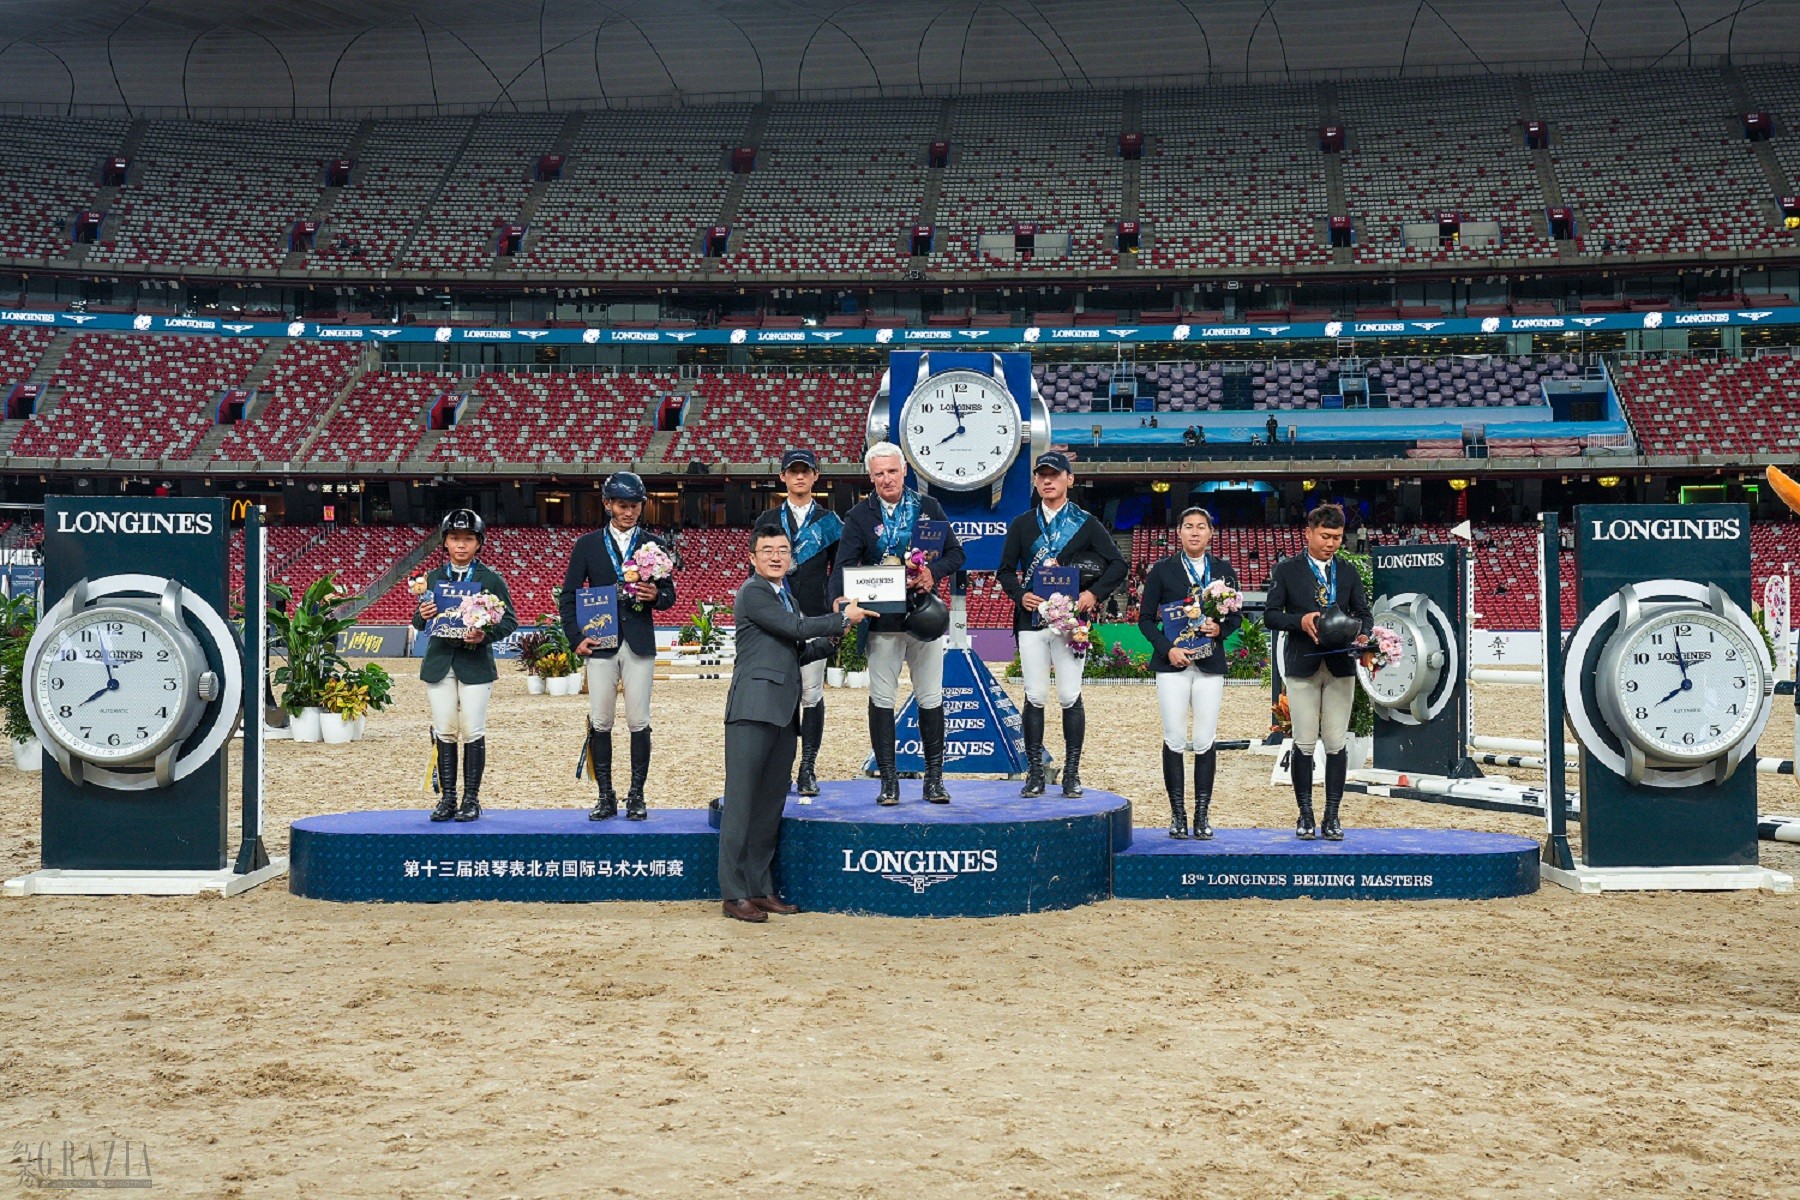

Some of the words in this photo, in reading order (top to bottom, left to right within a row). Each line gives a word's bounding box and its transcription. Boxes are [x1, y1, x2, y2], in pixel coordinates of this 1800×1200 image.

[1, 311, 55, 323] LONGINES
[1675, 313, 1730, 324] LONGINES
[164, 318, 215, 329] LONGINES
[1355, 323, 1404, 332] LONGINES
[1511, 318, 1564, 329] LONGINES
[316, 326, 363, 338] LONGINES
[463, 330, 511, 339] LONGINES
[611, 331, 659, 341] LONGINES
[758, 331, 805, 341] LONGINES
[904, 330, 951, 339] LONGINES
[1052, 329, 1100, 338] LONGINES
[1201, 327, 1250, 336] LONGINES
[936, 390, 944, 398] 11
[955, 384, 967, 393] 12
[981, 390, 985, 398] 1
[921, 404, 934, 413] 10
[992, 404, 1002, 413] 2
[914, 425, 924, 434] 9
[997, 425, 1007, 434] 3
[920, 445, 931, 455] 8
[990, 446, 1001, 455] 4
[936, 462, 945, 470] 7
[977, 462, 986, 471] 5
[955, 467, 966, 477] 6
[57, 511, 213, 535] LONGINES
[950, 521, 1008, 536] GINES
[1591, 518, 1741, 540] LONGINES
[1377, 552, 1445, 569] LONGINES
[856, 577, 894, 585] LONGINES
[106, 623, 123, 635] 12
[1675, 625, 1692, 637] 12
[81, 631, 92, 642] 11
[141, 631, 146, 642] 1
[1651, 634, 1663, 645] 11
[1709, 632, 1714, 643] 1
[61, 648, 77, 662] 10
[85, 650, 143, 660] LOGINES
[156, 650, 169, 662] 2
[1634, 653, 1650, 665] 10
[1725, 649, 1737, 661] 2
[51, 678, 64, 690] 9
[163, 678, 177, 691] 3
[1626, 680, 1638, 692] 9
[1733, 676, 1746, 689] 3
[941, 687, 974, 695] NGINES
[943, 700, 979, 710] GINES
[1726, 704, 1740, 715] 4
[59, 705, 73, 718] 8
[154, 706, 169, 718] 4
[1635, 707, 1648, 720] 8
[907, 717, 986, 729] LINES
[80, 726, 92, 739] 7
[136, 726, 149, 739] 5
[1656, 726, 1668, 739] 7
[1709, 725, 1721, 737] 5
[107, 733, 121, 746] 6
[1682, 732, 1695, 745] 6
[895, 740, 995, 755] LOINES
[842, 849, 998, 874] LONGINES
[403, 860, 684, 878] 第十三届浪琴表北京国际马术大师赛
[1207, 874, 1287, 886] LONGINES
[1293, 874, 1356, 887] BEIJING
[1361, 875, 1433, 887] MASTERS
